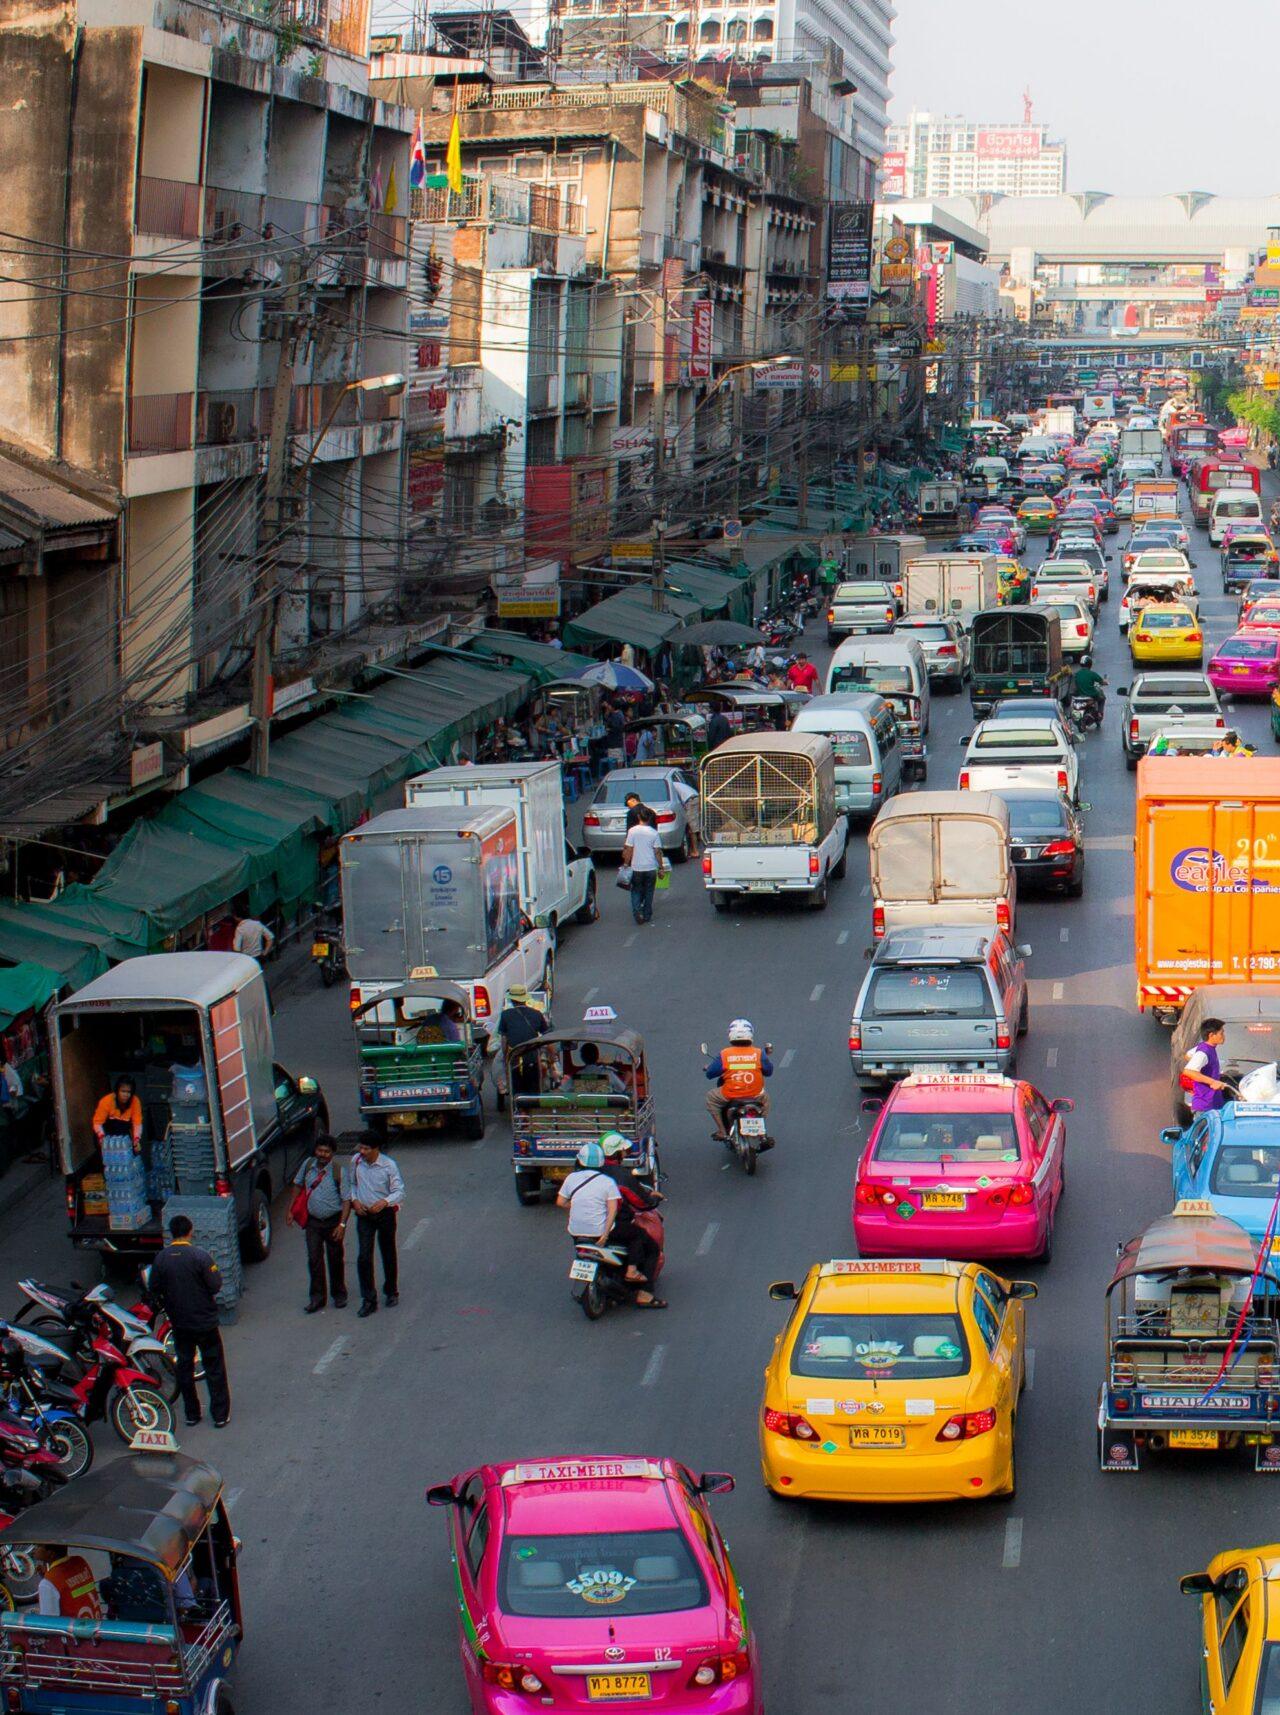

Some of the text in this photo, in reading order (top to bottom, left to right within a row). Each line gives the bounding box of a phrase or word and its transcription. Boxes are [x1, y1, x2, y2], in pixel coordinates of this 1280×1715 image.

[612, 438, 676, 450] SHAP
[1175, 862, 1250, 885] eagles
[1195, 885, 1222, 893] Grup
[1223, 885, 1233, 893] of
[1157, 957, 1223, 970] www.eaglesthaiom
[414, 967, 433, 976] TAXI
[587, 1008, 609, 1017] TAXI
[927, 1075, 987, 1083] TAXI-METER
[384, 1087, 448, 1097] THAILAND
[1182, 1202, 1210, 1211] TAXI
[847, 1262, 921, 1272] TAXI-METER
[1149, 1396, 1245, 1408] THAILAND
[139, 1433, 168, 1445] TAXI
[873, 1428, 900, 1439] 7019
[539, 1464, 625, 1479] TAXI-METER
[566, 1570, 637, 1595] 55097
[615, 1674, 647, 1689] 8772
